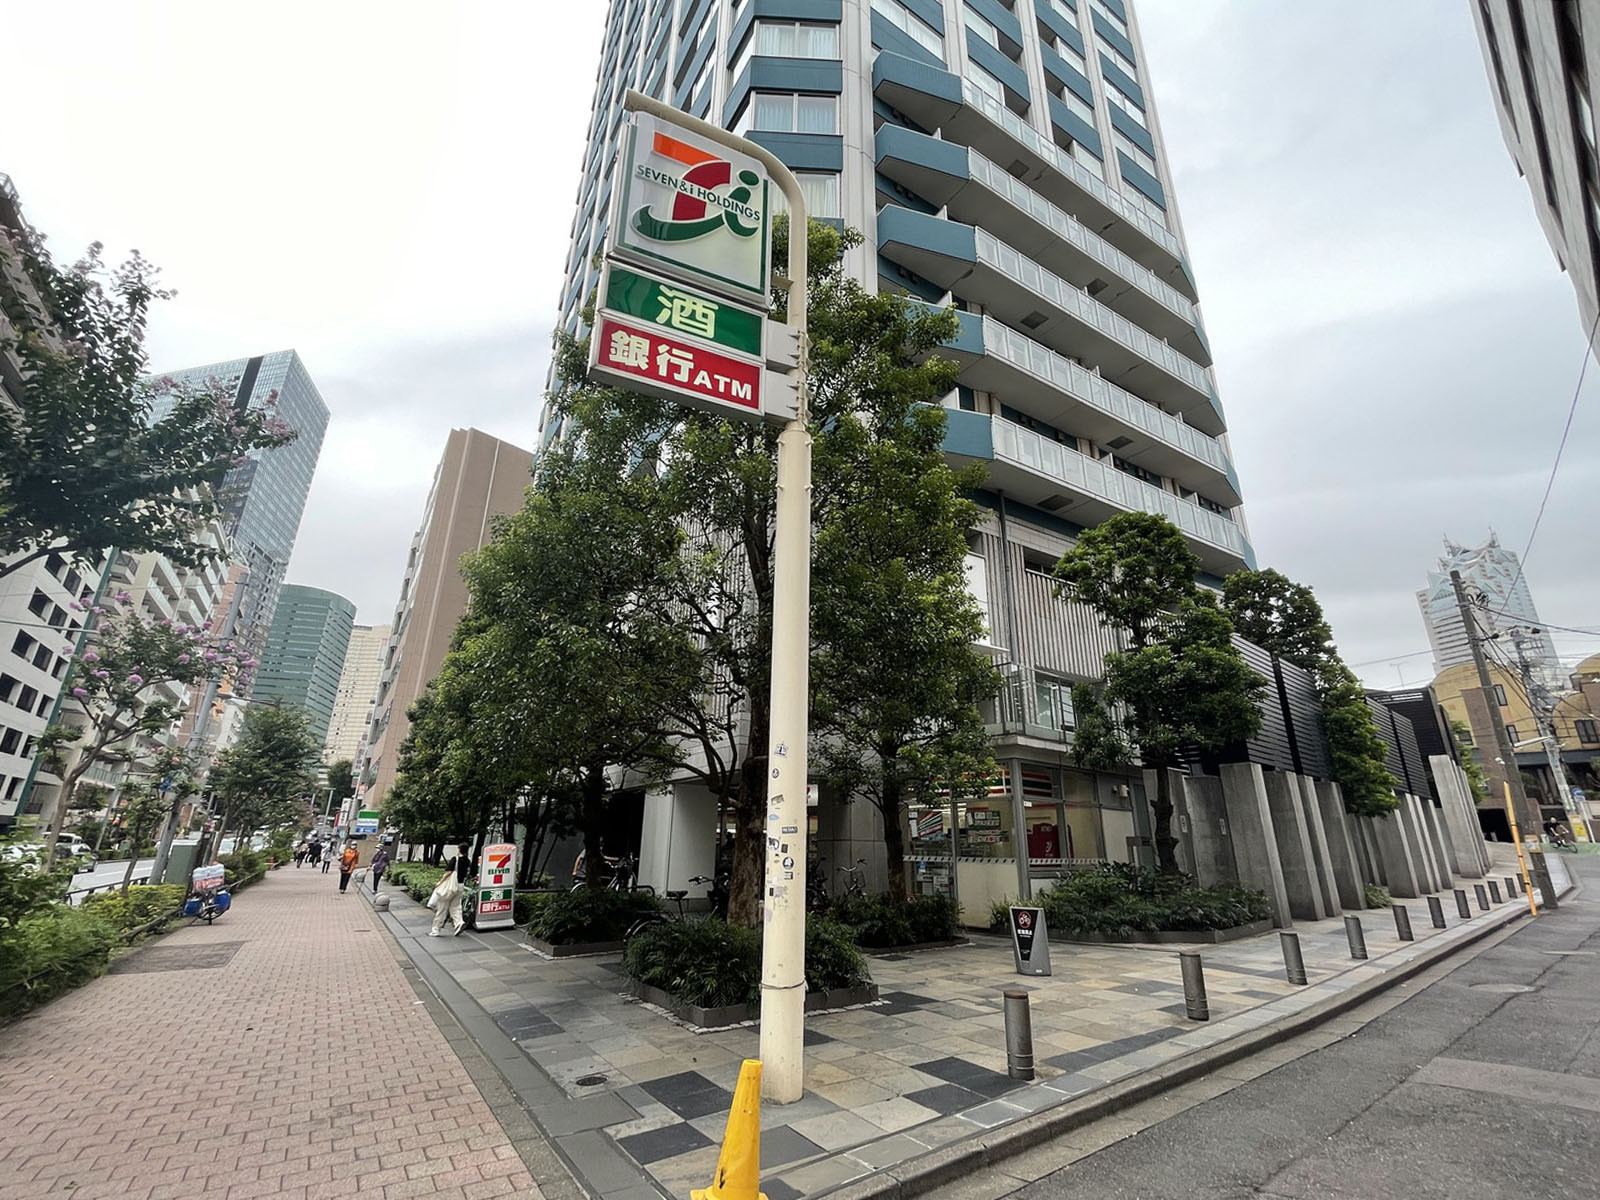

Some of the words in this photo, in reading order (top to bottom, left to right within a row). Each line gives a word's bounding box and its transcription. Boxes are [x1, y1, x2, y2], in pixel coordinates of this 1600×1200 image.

[697, 189, 760, 221] HOLDINGS
[655, 284, 719, 339] 酒
[608, 329, 752, 401] 銀行ATM
